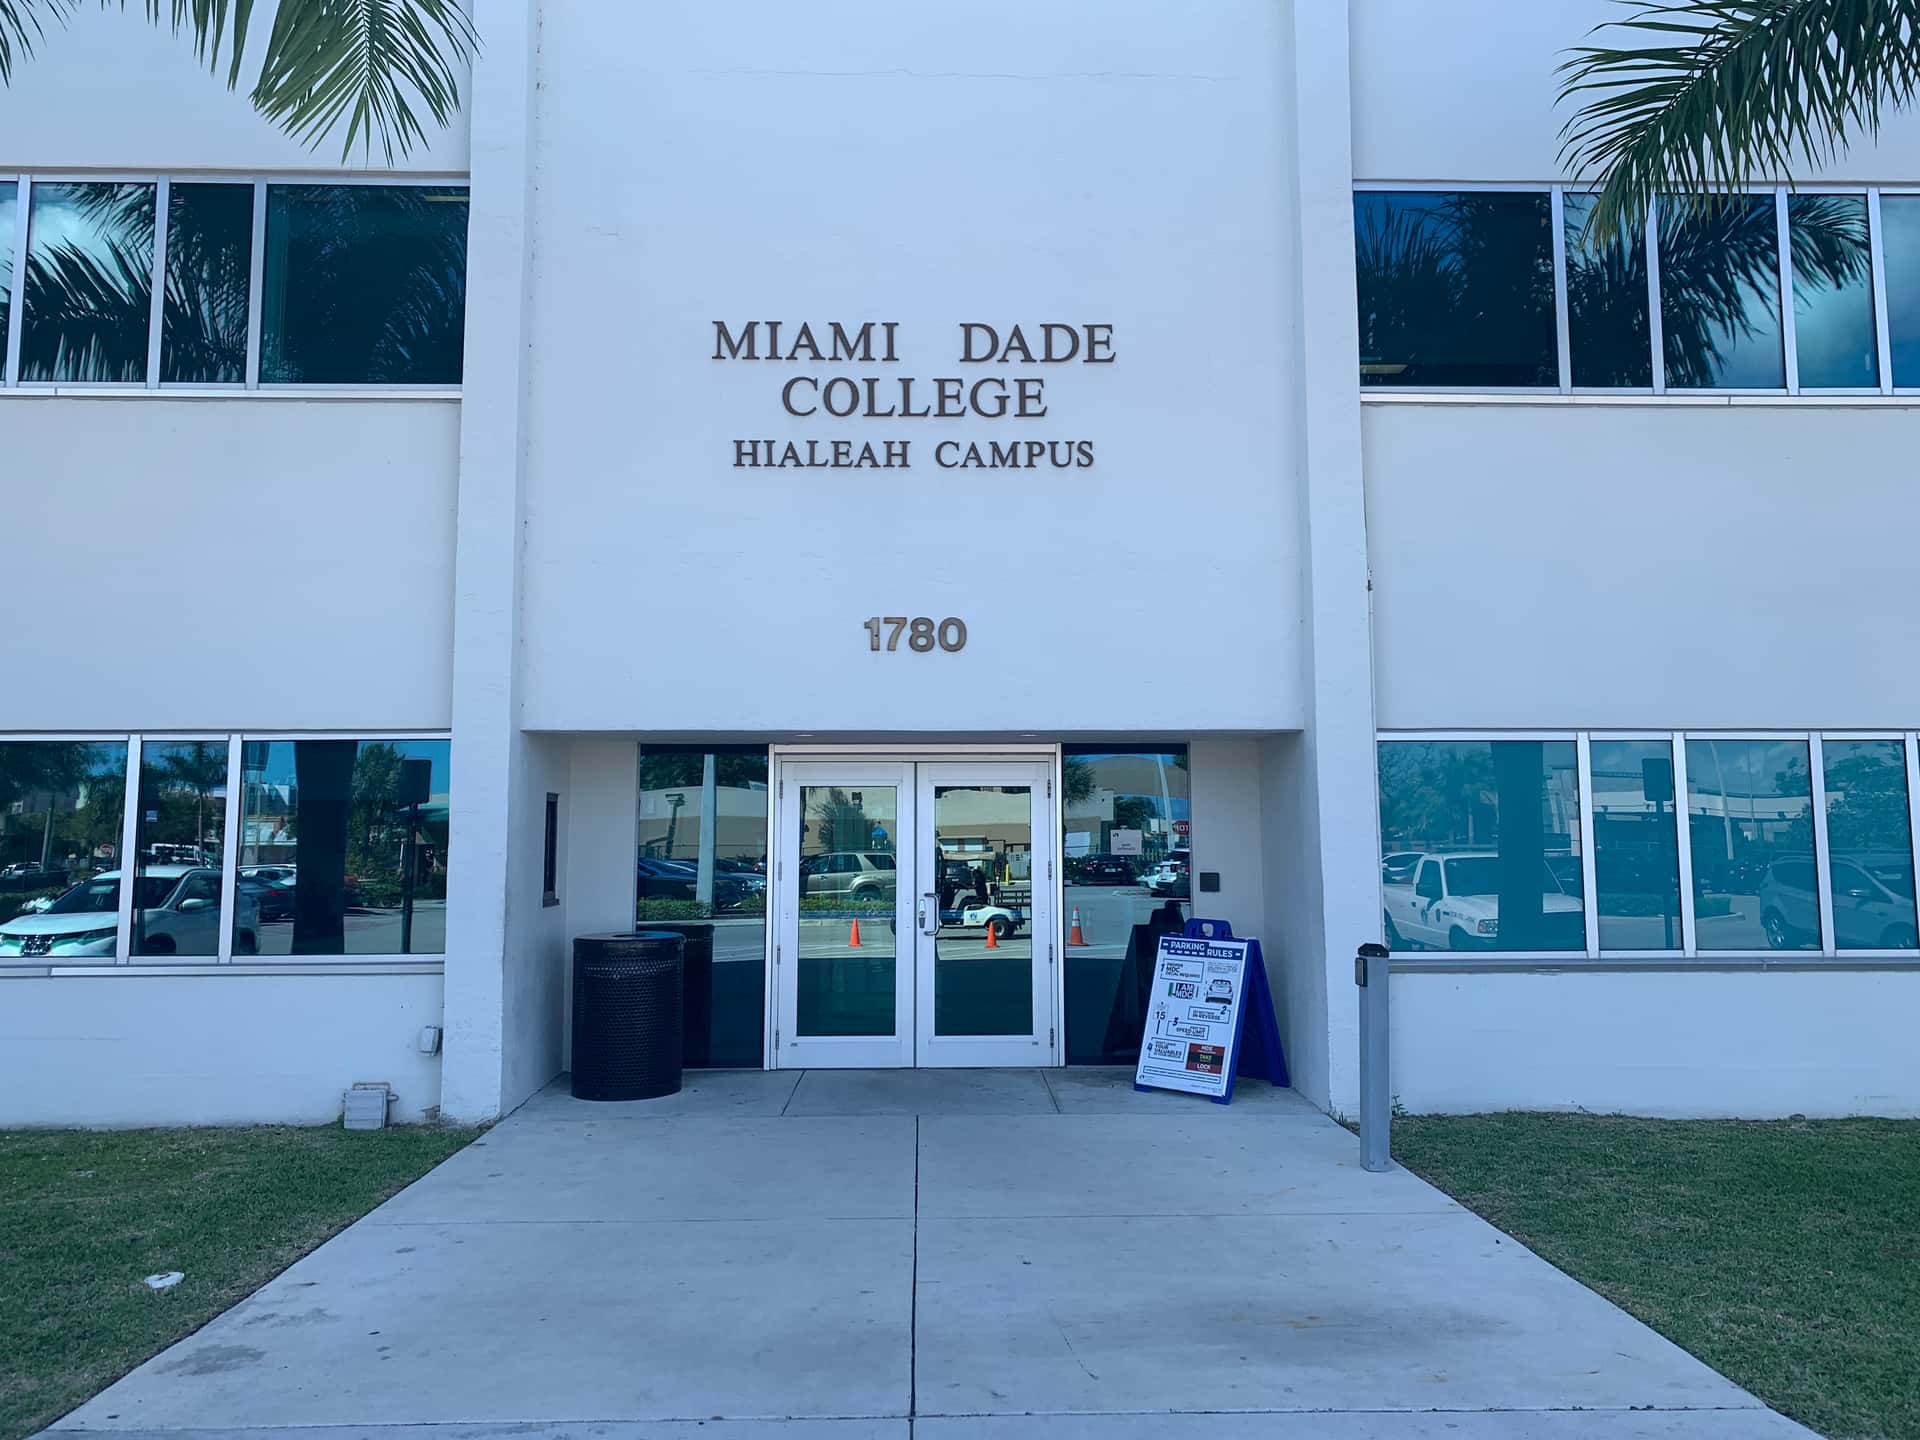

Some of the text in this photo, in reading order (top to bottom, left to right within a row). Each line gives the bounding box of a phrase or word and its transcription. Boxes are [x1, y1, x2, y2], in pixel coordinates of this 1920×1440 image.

[711, 320, 1117, 364] MIAMI DADE
[781, 376, 1048, 418] COLLEGE
[732, 439, 1095, 468] HIALEAH CAMPUS
[863, 616, 967, 652] 1780
[1170, 941, 1233, 958] PARKING RULES
[1180, 983, 1194, 992] AM
[1175, 990, 1193, 999] MDC
[1156, 1011, 1166, 1020] 15
[1220, 1005, 1227, 1015] 2
[1172, 1017, 1179, 1026] 3
